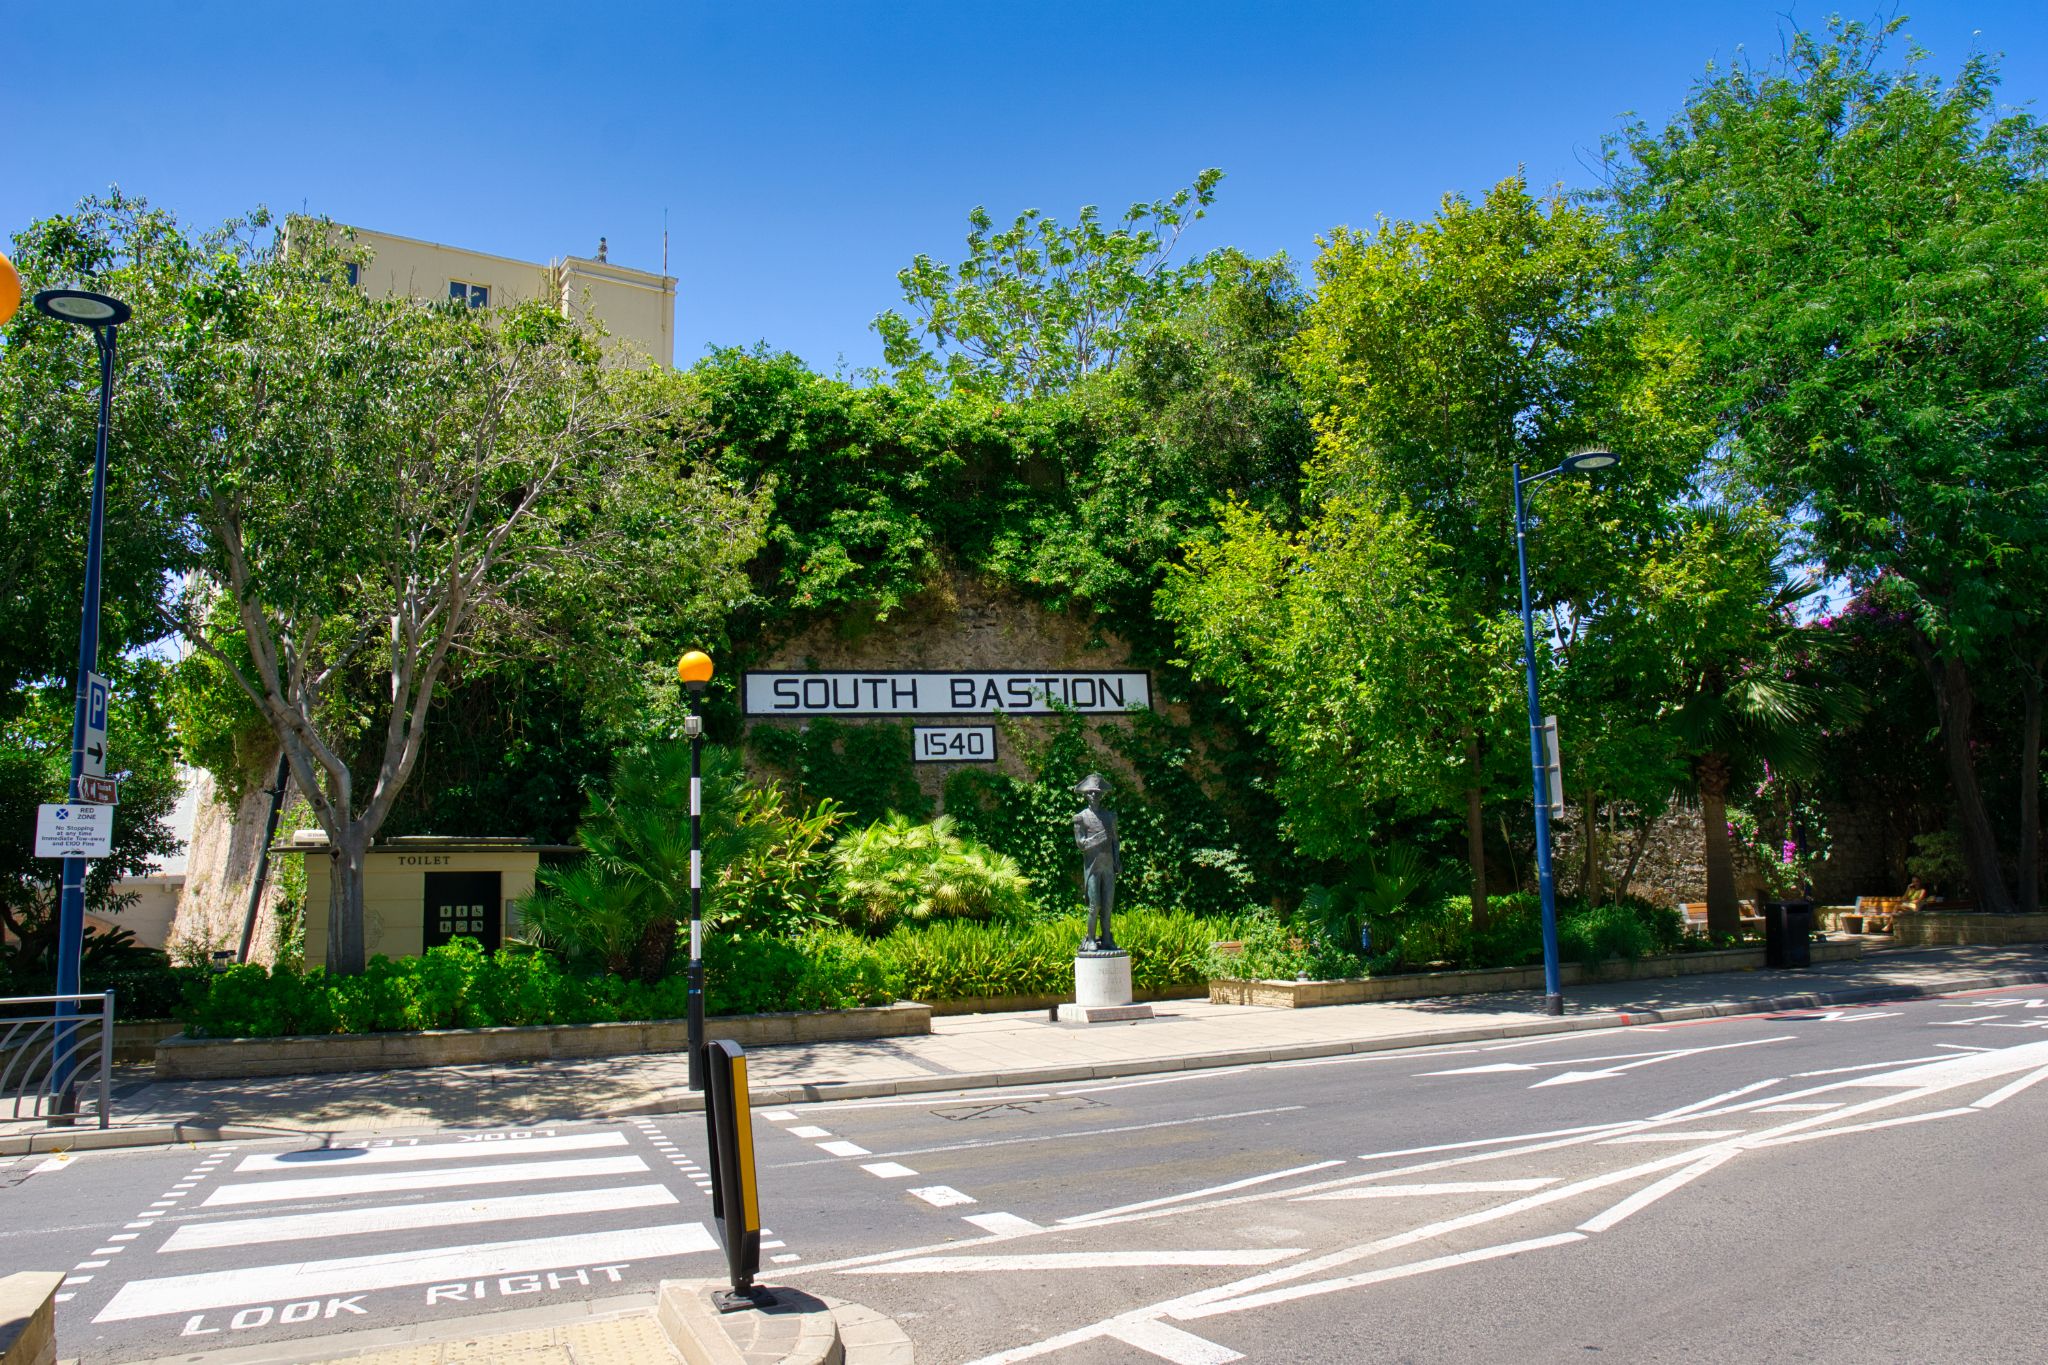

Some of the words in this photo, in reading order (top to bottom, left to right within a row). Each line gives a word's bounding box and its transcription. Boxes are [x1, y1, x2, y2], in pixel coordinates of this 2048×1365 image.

[92, 687, 103, 724] P
[773, 678, 918, 709] SOUTH
[949, 678, 1125, 709] BASTION
[923, 732, 985, 756] 1540
[398, 856, 451, 865] TOILET
[457, 1130, 555, 1142] LOOK
[179, 1295, 369, 1337] LOOK
[426, 1264, 631, 1306] RIGHT
